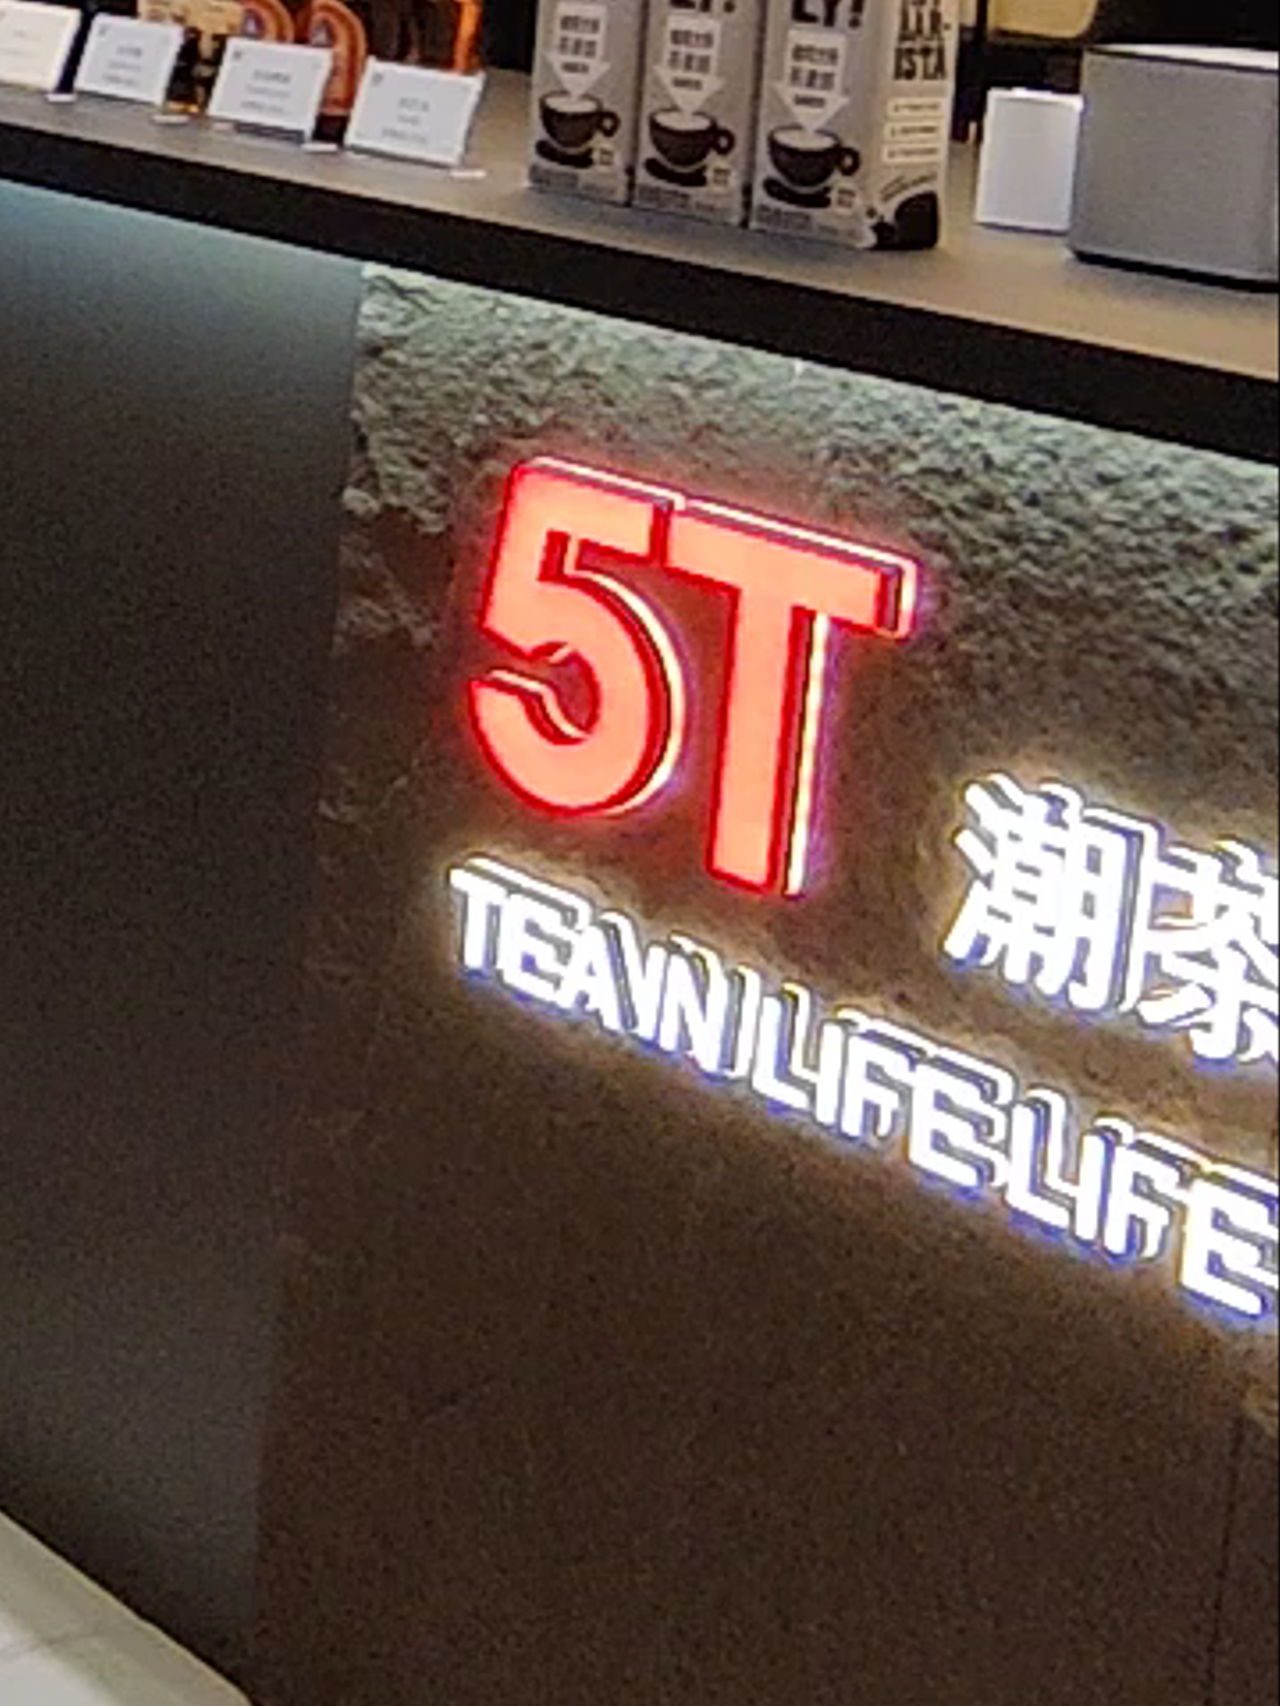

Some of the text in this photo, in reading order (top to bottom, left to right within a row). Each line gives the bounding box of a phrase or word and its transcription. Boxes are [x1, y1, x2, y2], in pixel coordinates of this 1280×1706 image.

[469, 455, 920, 899] 5T
[448, 856, 1280, 1321] TEA IN LIFE LIFE
